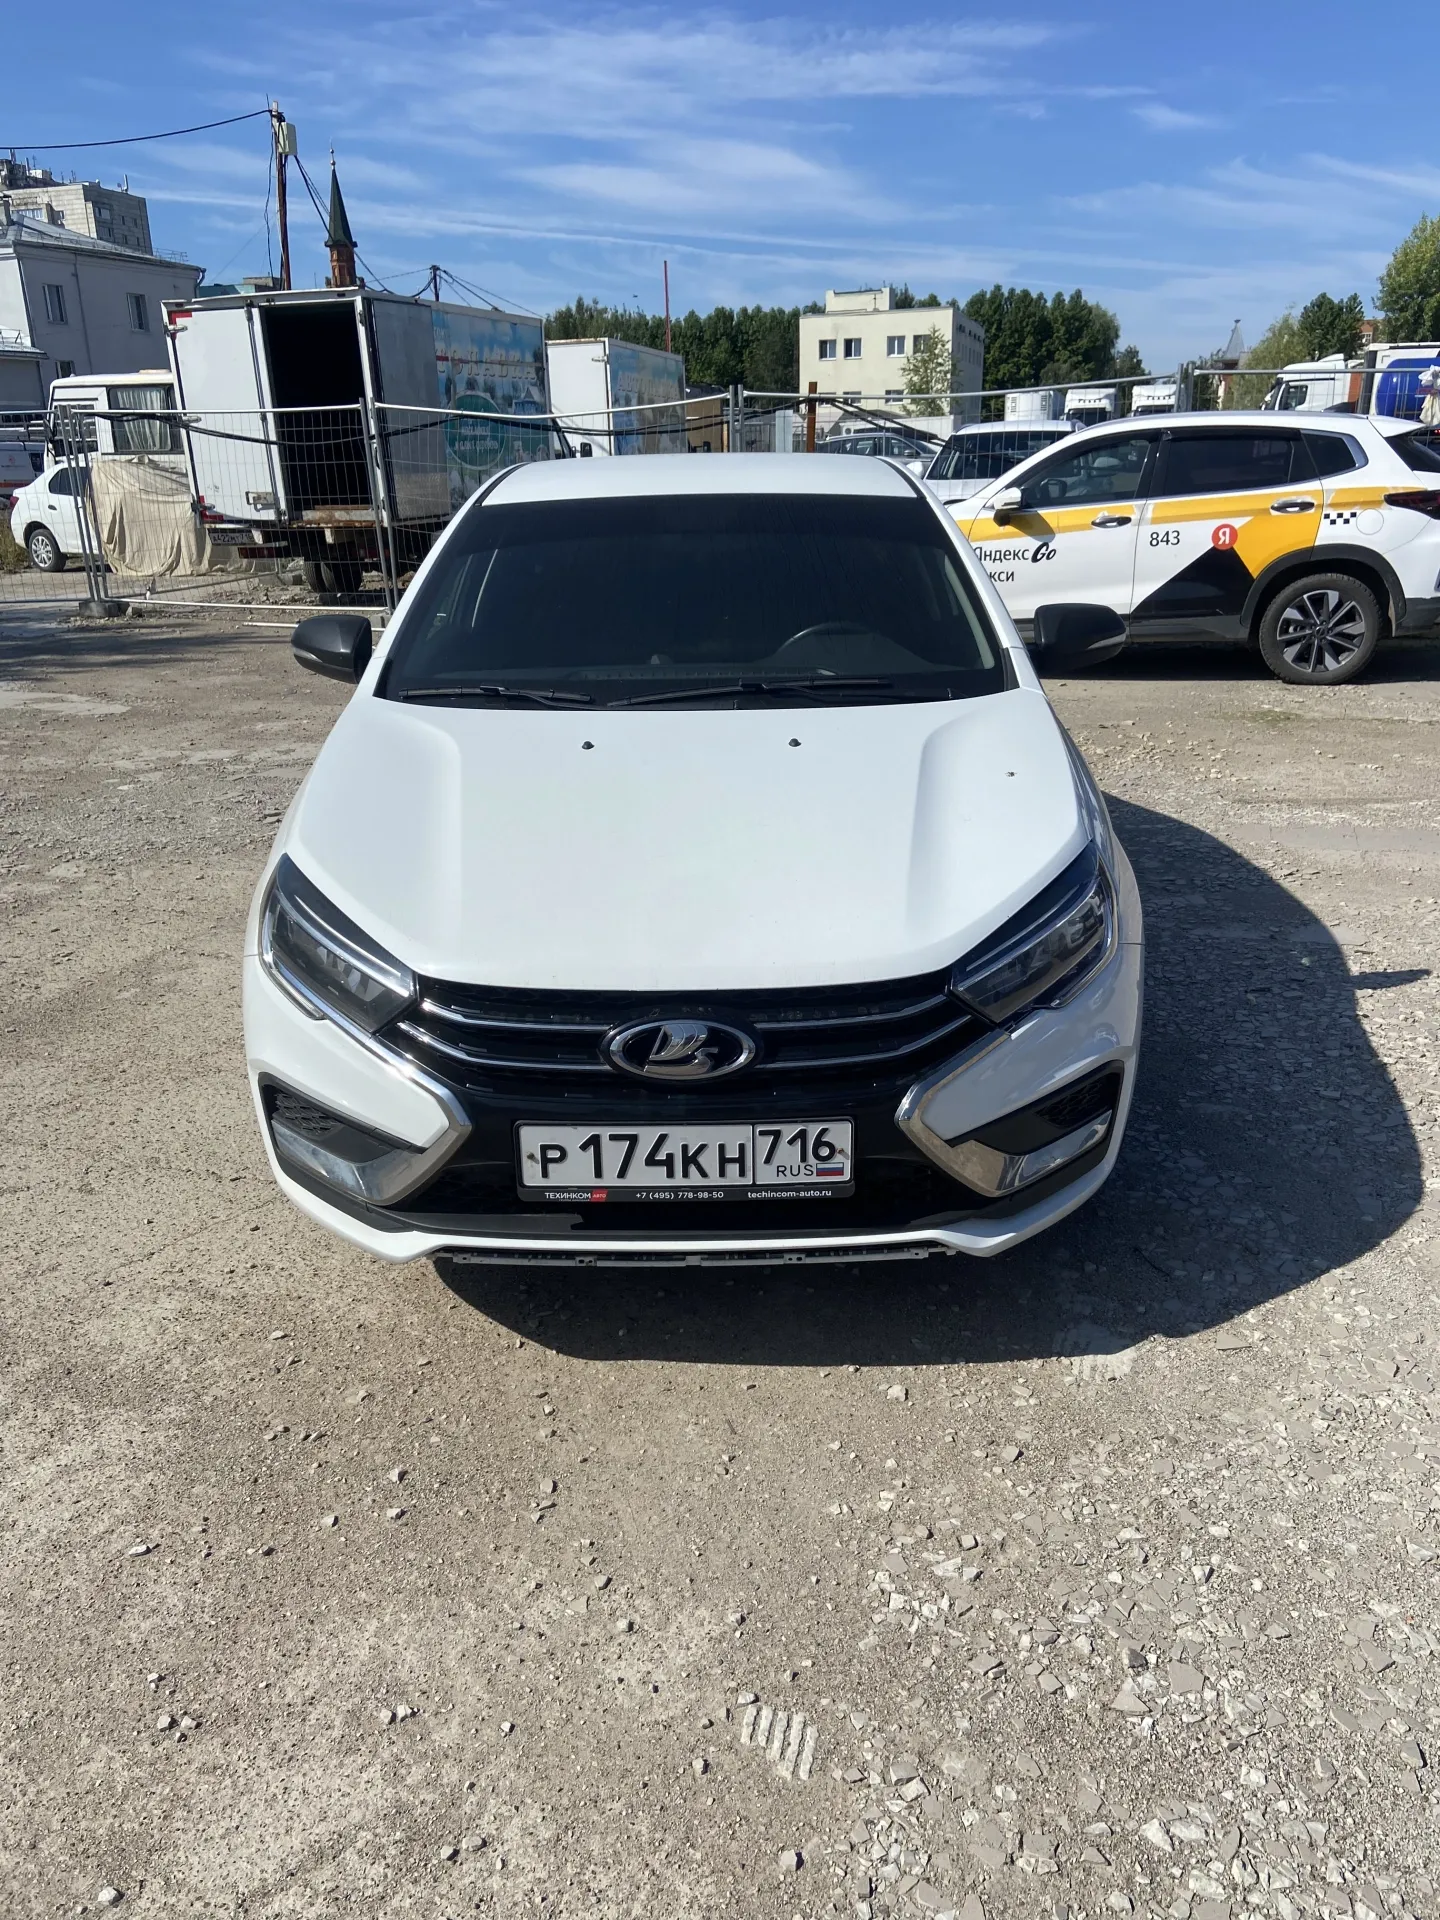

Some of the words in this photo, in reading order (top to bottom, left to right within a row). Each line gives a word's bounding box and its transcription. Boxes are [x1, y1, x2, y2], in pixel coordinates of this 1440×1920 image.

[1149, 530, 1180, 547] 843
[1218, 528, 1231, 545] Я
[1031, 542, 1057, 563] Go
[757, 1127, 836, 1165] 716
[776, 1164, 814, 1177] RUS
[649, 1192, 674, 1200] (495)
[677, 1191, 724, 1199] 778-98-50
[747, 1190, 832, 1198] techincom-auto.ru
